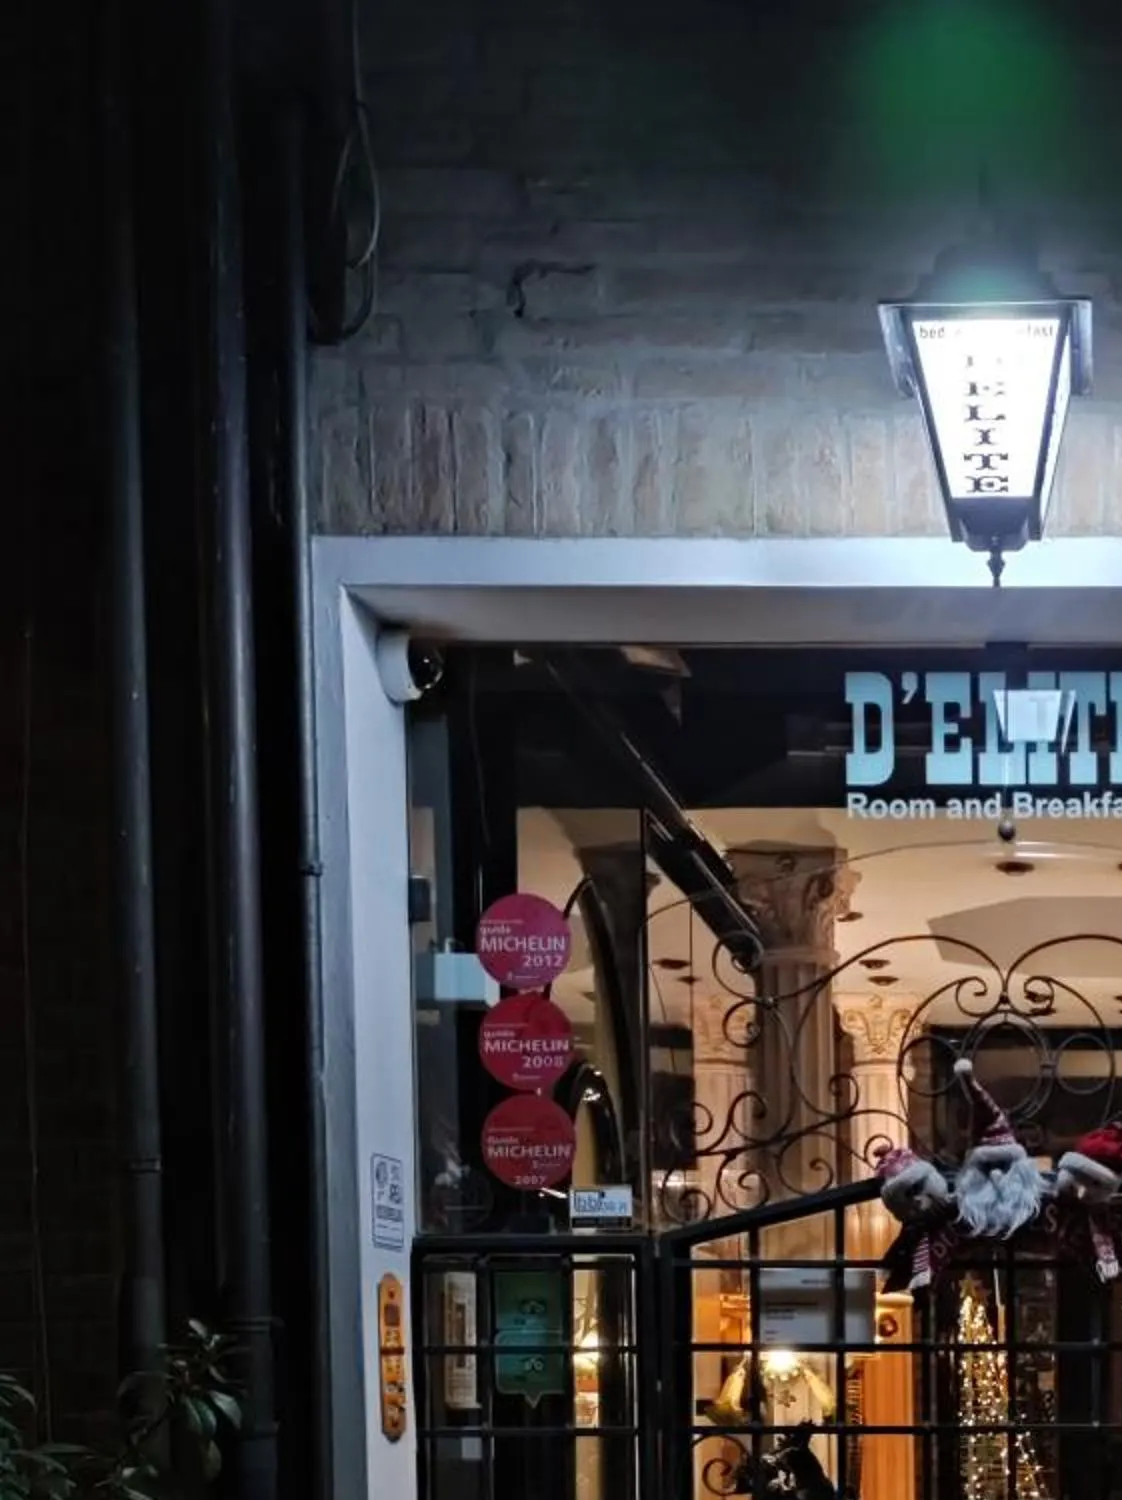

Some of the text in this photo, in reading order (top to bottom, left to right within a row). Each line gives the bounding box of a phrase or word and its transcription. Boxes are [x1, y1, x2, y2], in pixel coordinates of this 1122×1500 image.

[847, 793, 935, 820] Room
[946, 793, 1001, 820] and
[480, 935, 566, 953] MICHELIN
[522, 954, 563, 968] 2012
[484, 1039, 569, 1053] MICHELIN
[487, 1146, 572, 1160] MICHELIN
